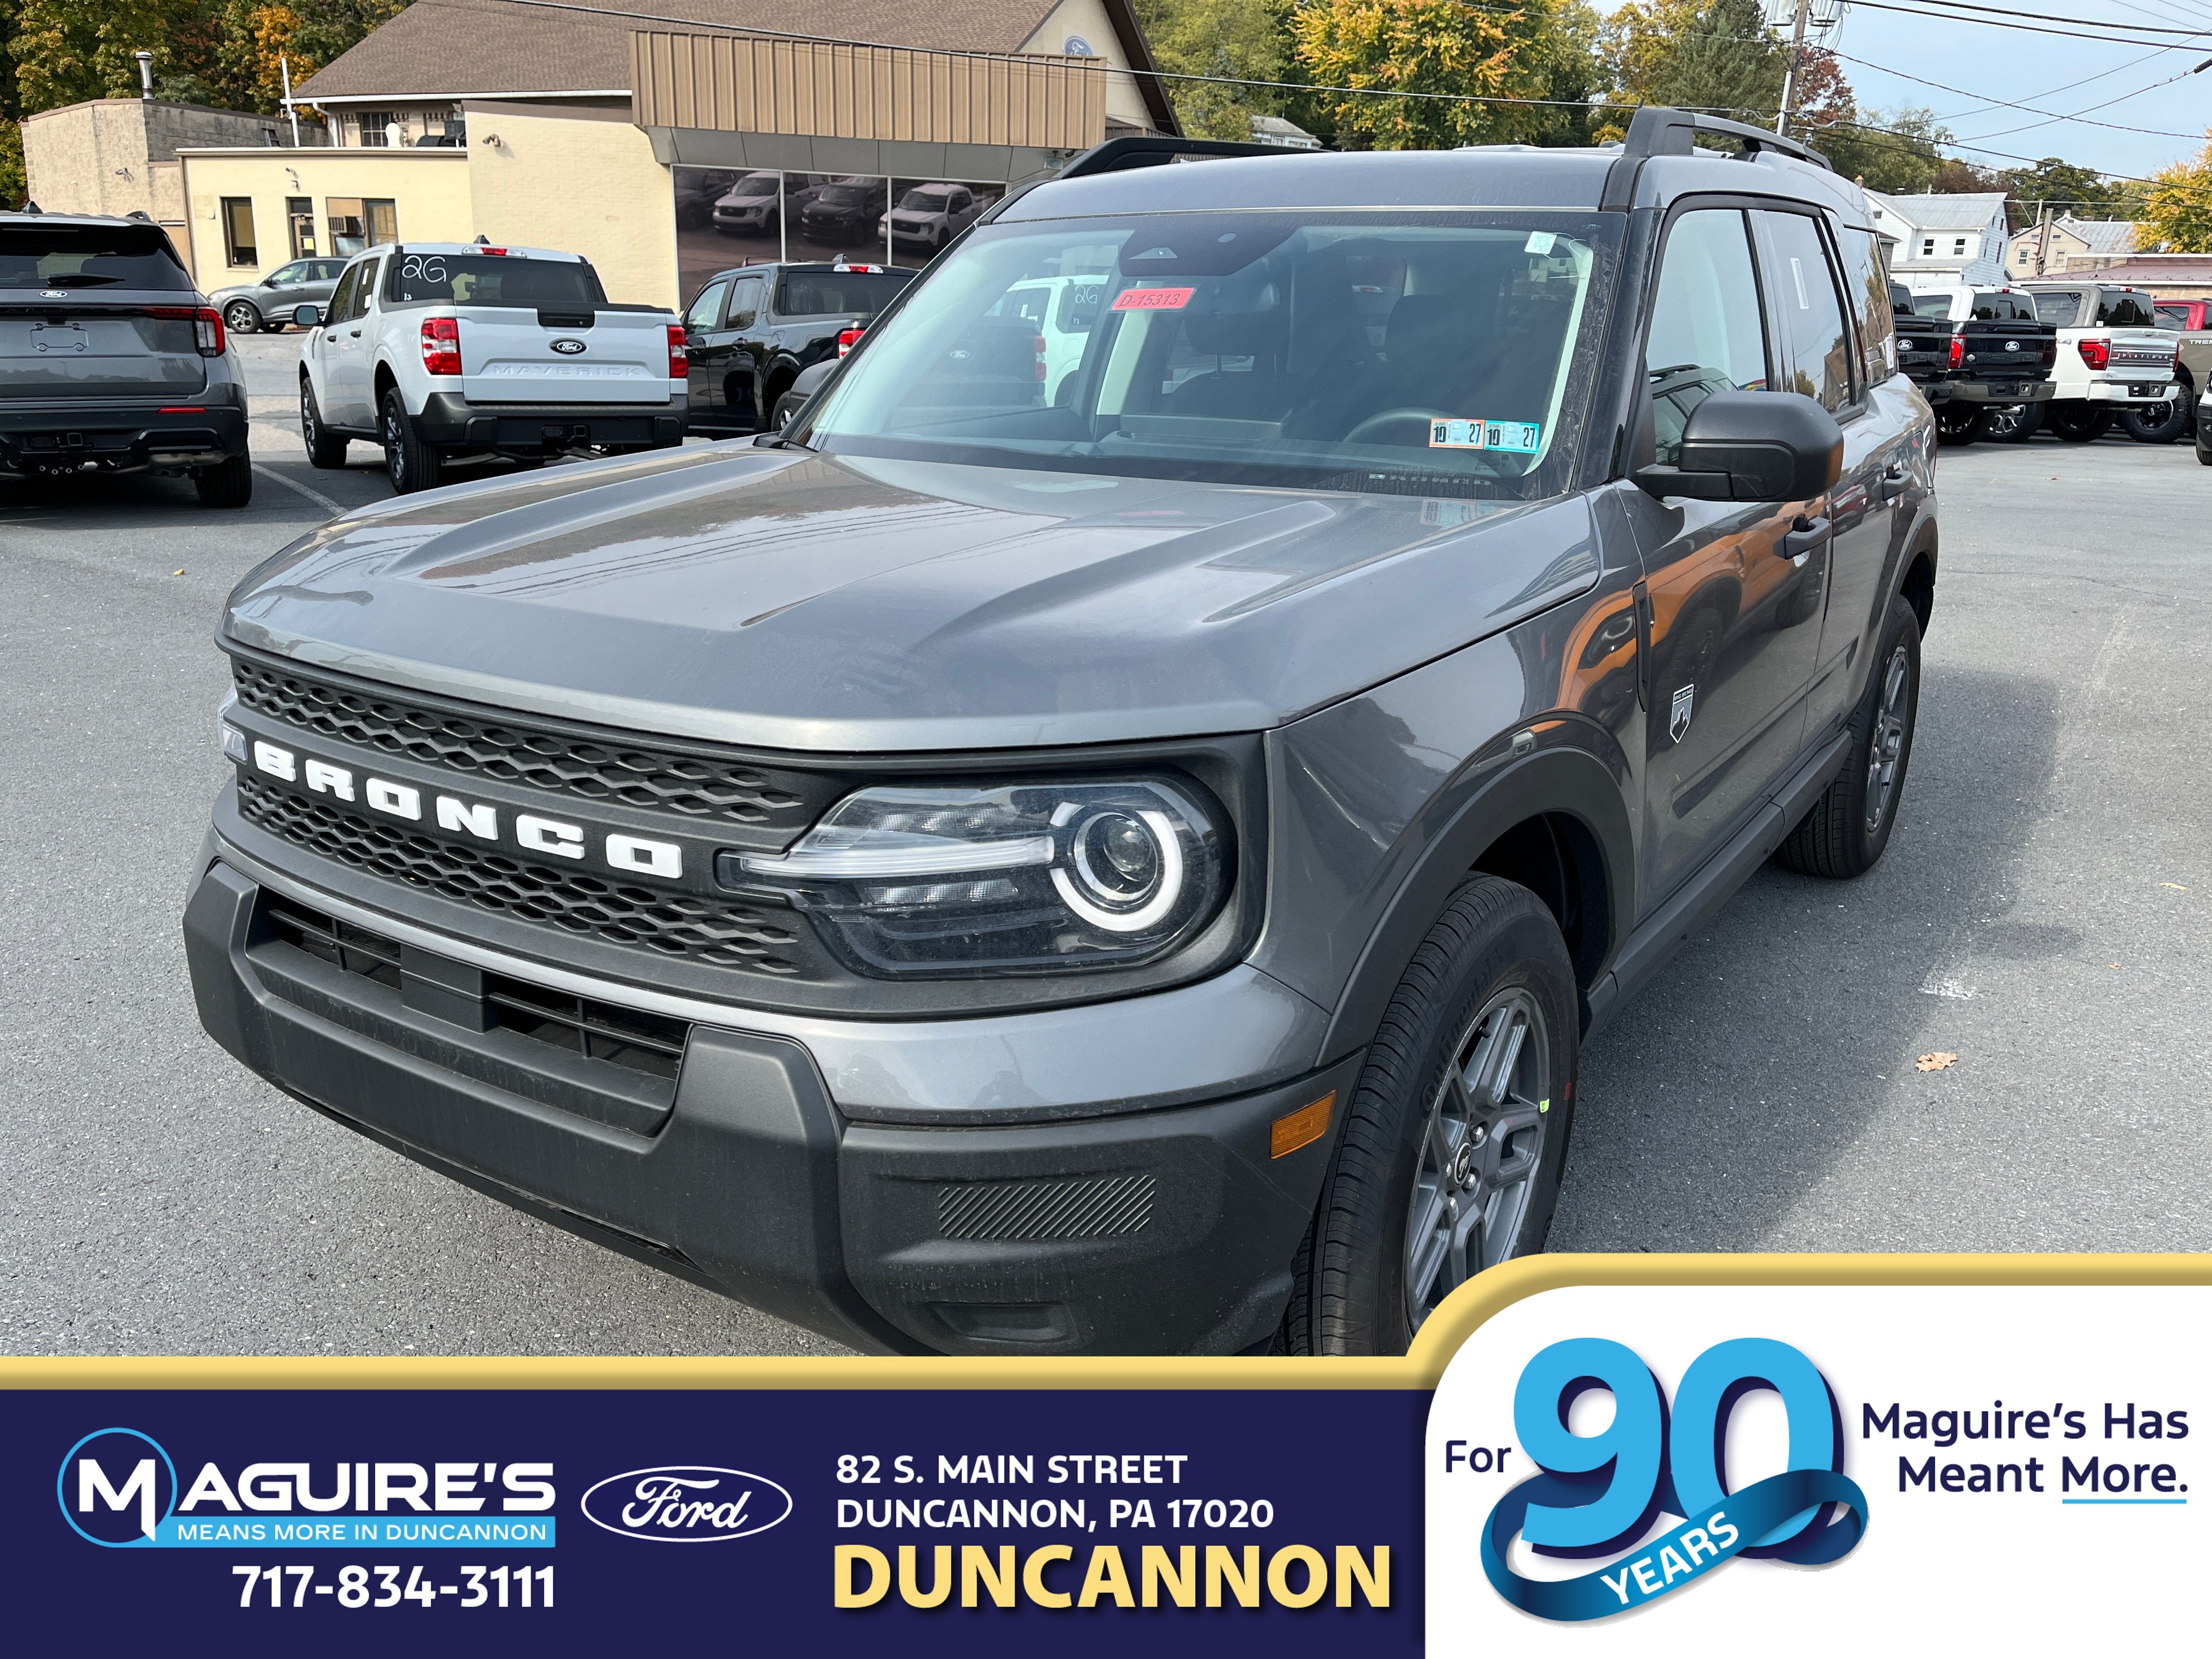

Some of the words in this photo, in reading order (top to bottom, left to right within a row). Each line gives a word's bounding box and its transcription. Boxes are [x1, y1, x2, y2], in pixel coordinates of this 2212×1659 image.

[1119, 294, 1181, 306] D-15313
[494, 366, 640, 376] MAVERICK
[1469, 423, 1481, 443] 27
[1523, 427, 1536, 448] 27
[253, 740, 682, 879] BRONCO
